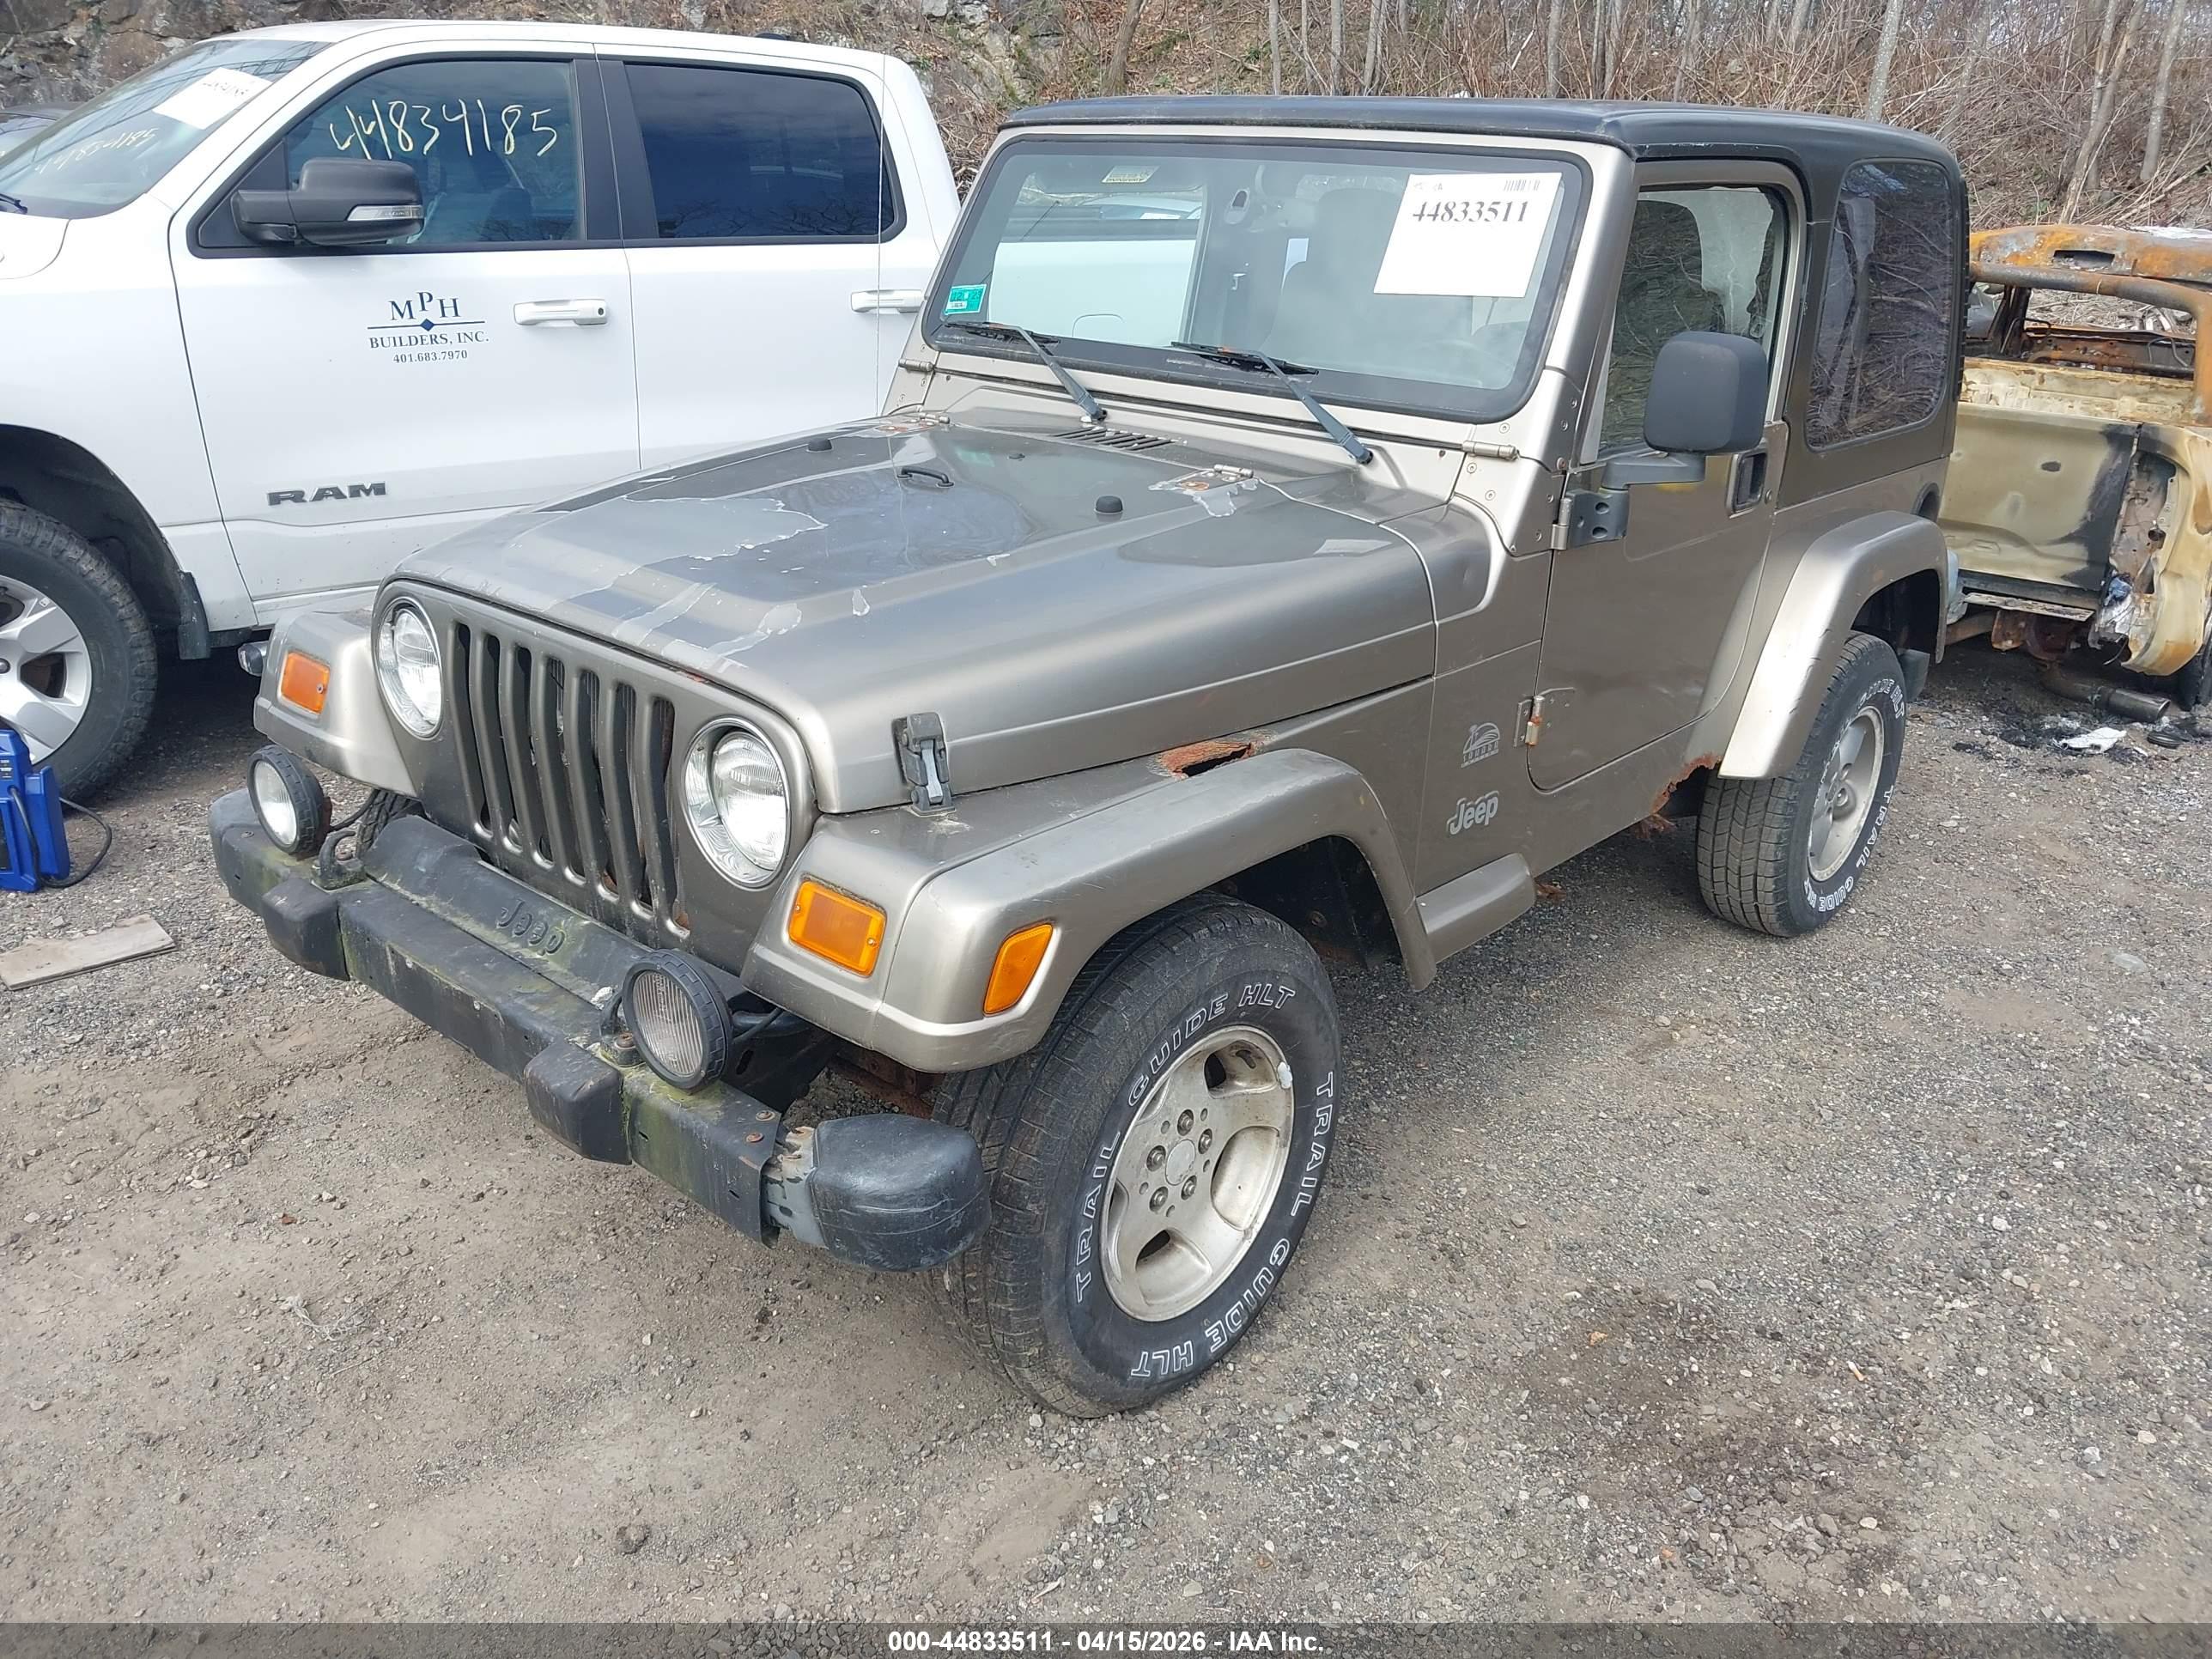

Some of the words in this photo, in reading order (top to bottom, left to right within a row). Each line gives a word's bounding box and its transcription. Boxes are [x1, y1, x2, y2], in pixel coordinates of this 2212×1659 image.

[329, 98, 558, 161] 44834185
[1413, 200, 1528, 223] 44833511
[388, 291, 462, 321] MPH
[369, 333, 453, 349] BUILDERS,
[455, 331, 489, 343] INC.
[393, 349, 468, 363] 401.683.7970
[267, 482, 386, 507] RAM
[1449, 798, 1498, 835] Jeep
[1856, 784, 1894, 869] TRAIL
[1818, 876, 1854, 913] GUIDE
[495, 898, 567, 955] Jeep
[1076, 1131, 1121, 1304] TRAIL
[1127, 992, 1229, 1107] GUIDE
[1238, 982, 1296, 1010] HLT
[1290, 1071, 1334, 1217] TRAIL
[1205, 1237, 1291, 1353] GUIDE
[1130, 1340, 1194, 1377] HLT
